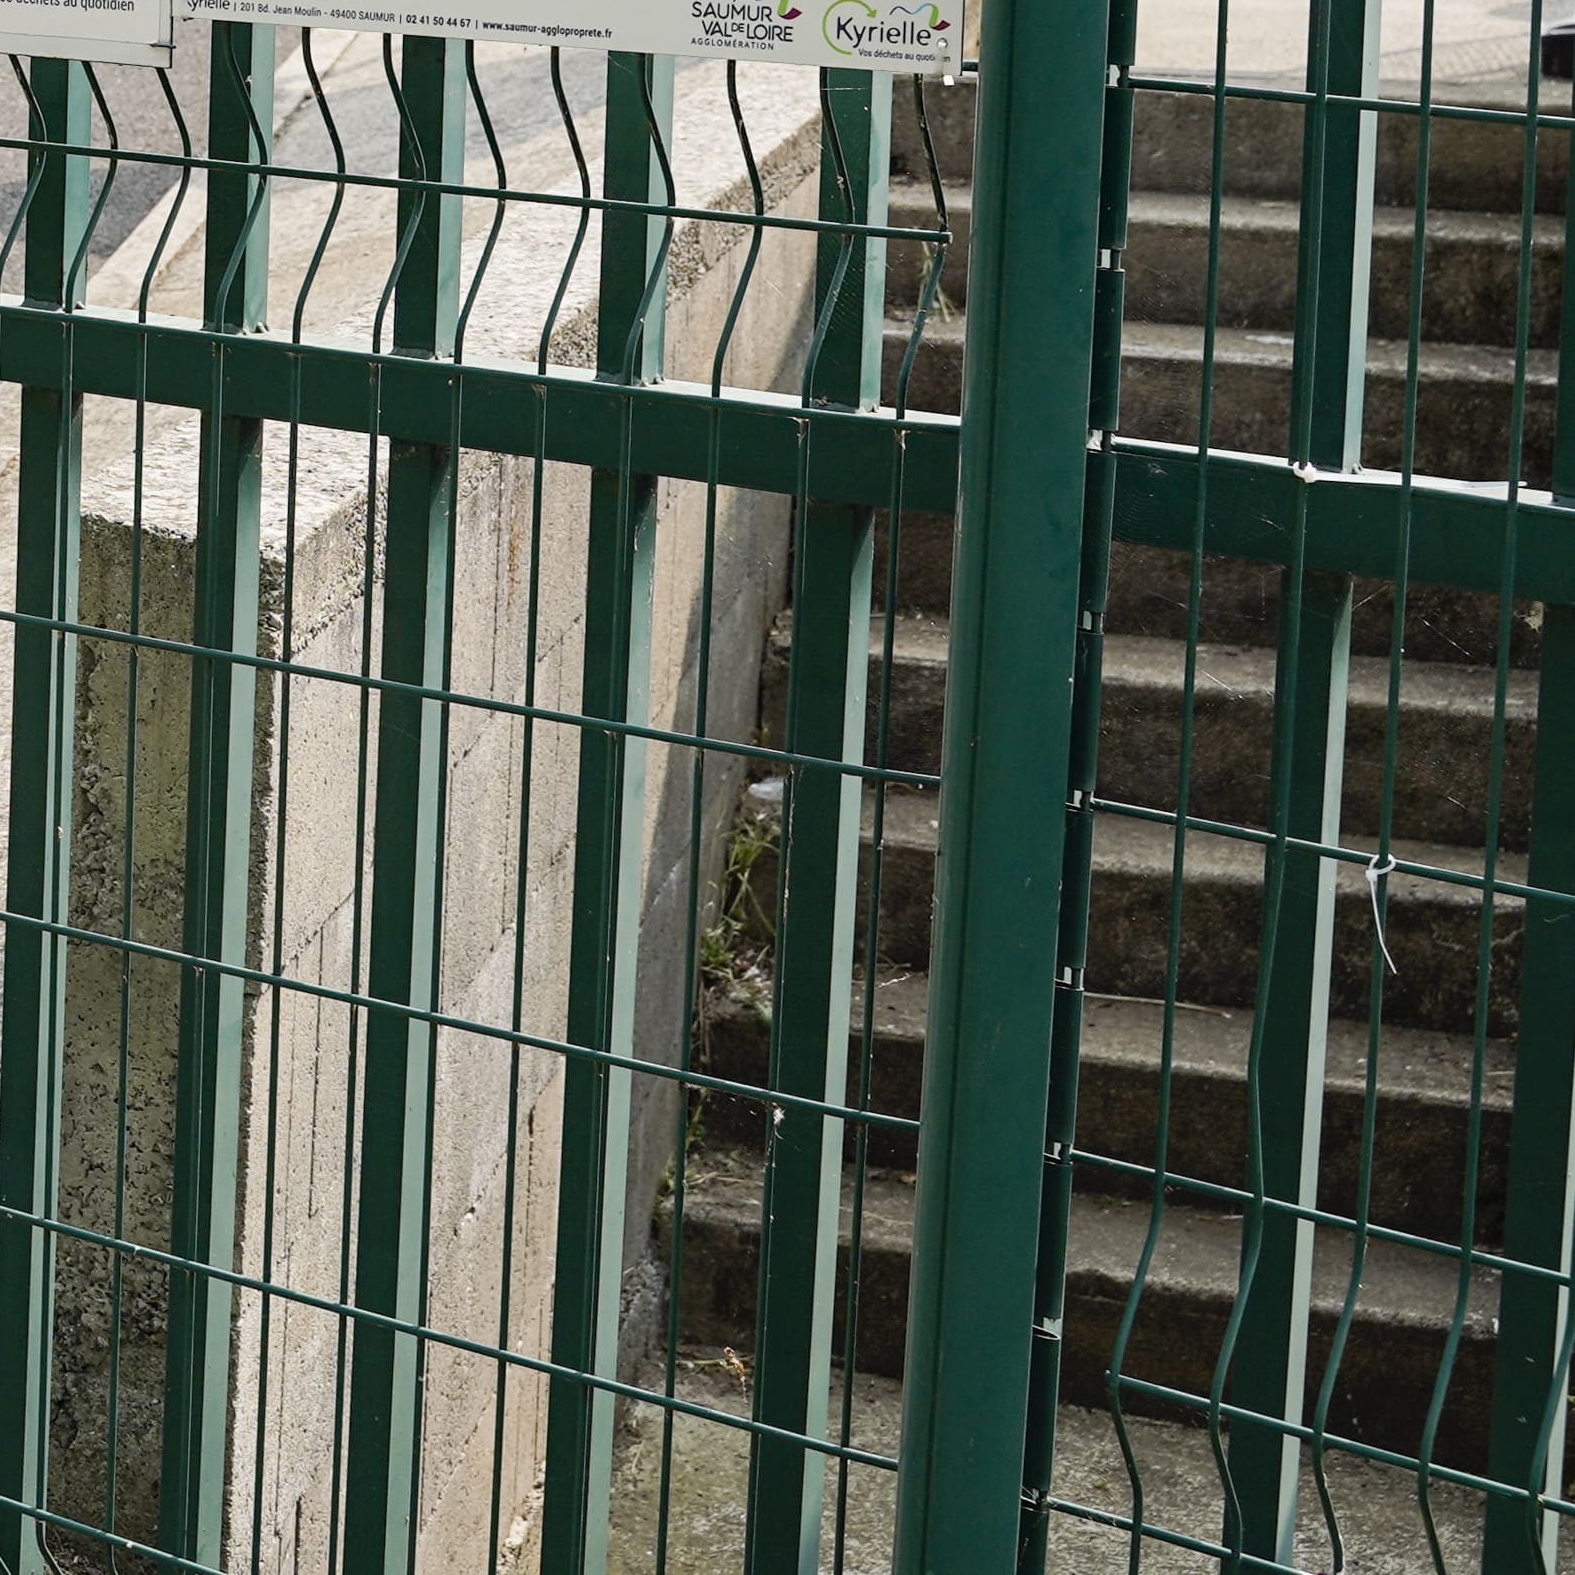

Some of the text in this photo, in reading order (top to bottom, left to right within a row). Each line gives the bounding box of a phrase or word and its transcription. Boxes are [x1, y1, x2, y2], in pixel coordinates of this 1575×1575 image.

[691, 1, 773, 23] SAUMUR
[701, 21, 794, 43] VAL DE LOIRE
[837, 16, 932, 49] Kyrielle
[691, 37, 775, 51] AGGLOMÉRATION
